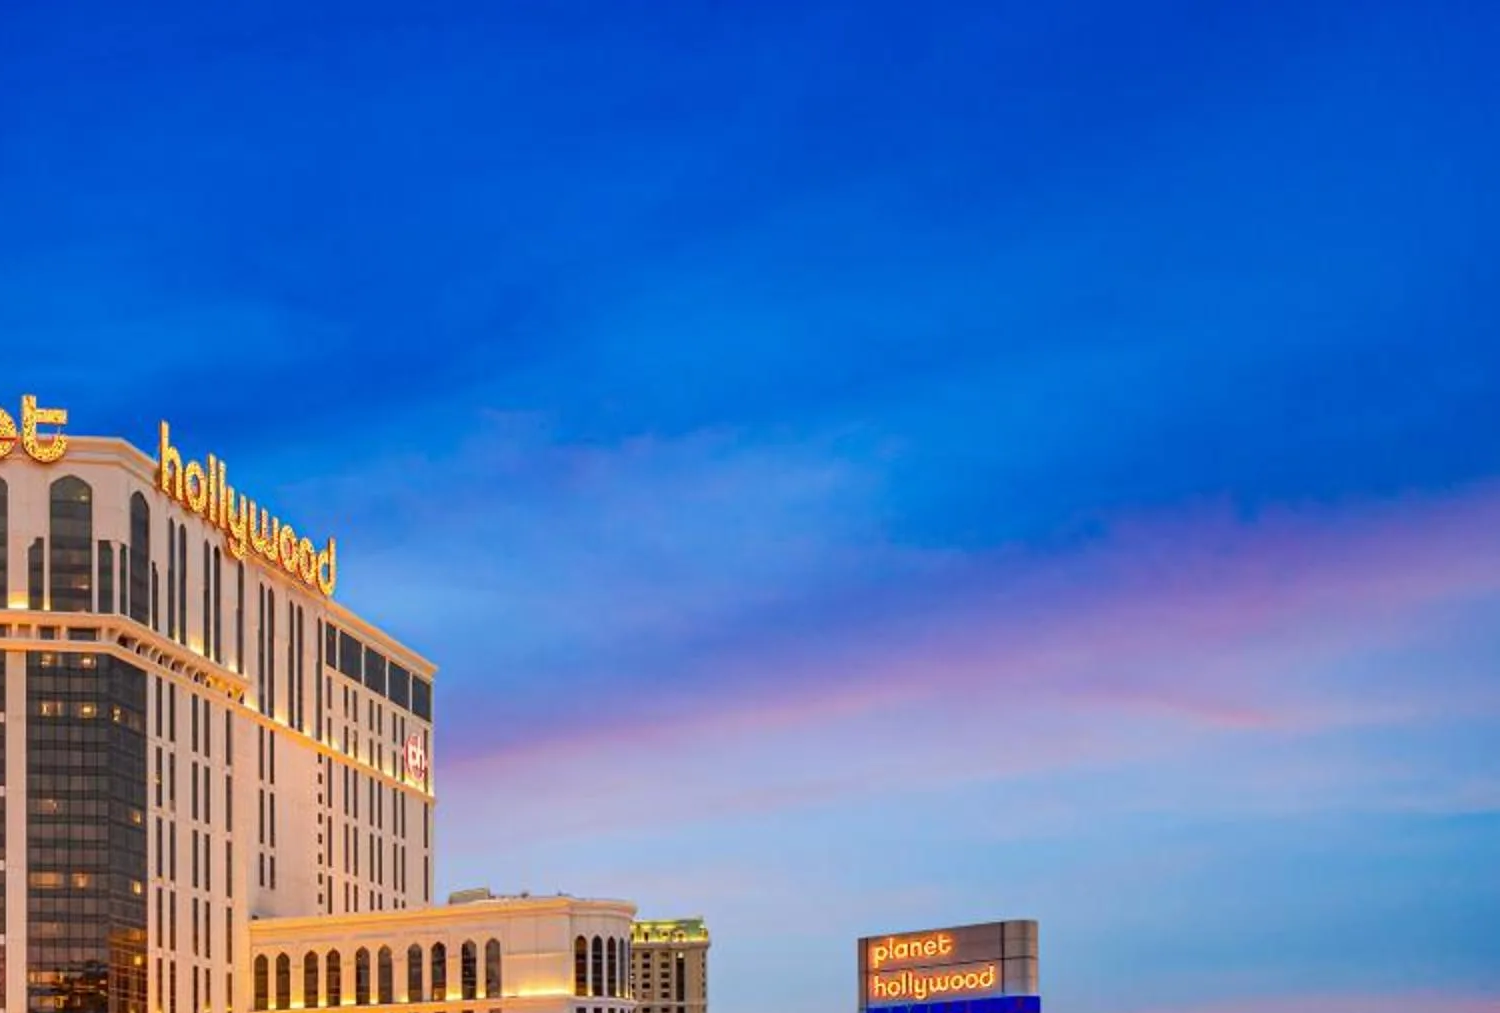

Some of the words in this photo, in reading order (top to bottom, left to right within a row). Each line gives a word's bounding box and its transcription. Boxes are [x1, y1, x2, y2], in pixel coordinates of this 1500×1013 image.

[160, 419, 337, 597] hollywood
[873, 934, 953, 968] planet
[874, 964, 995, 1000] hollywood
